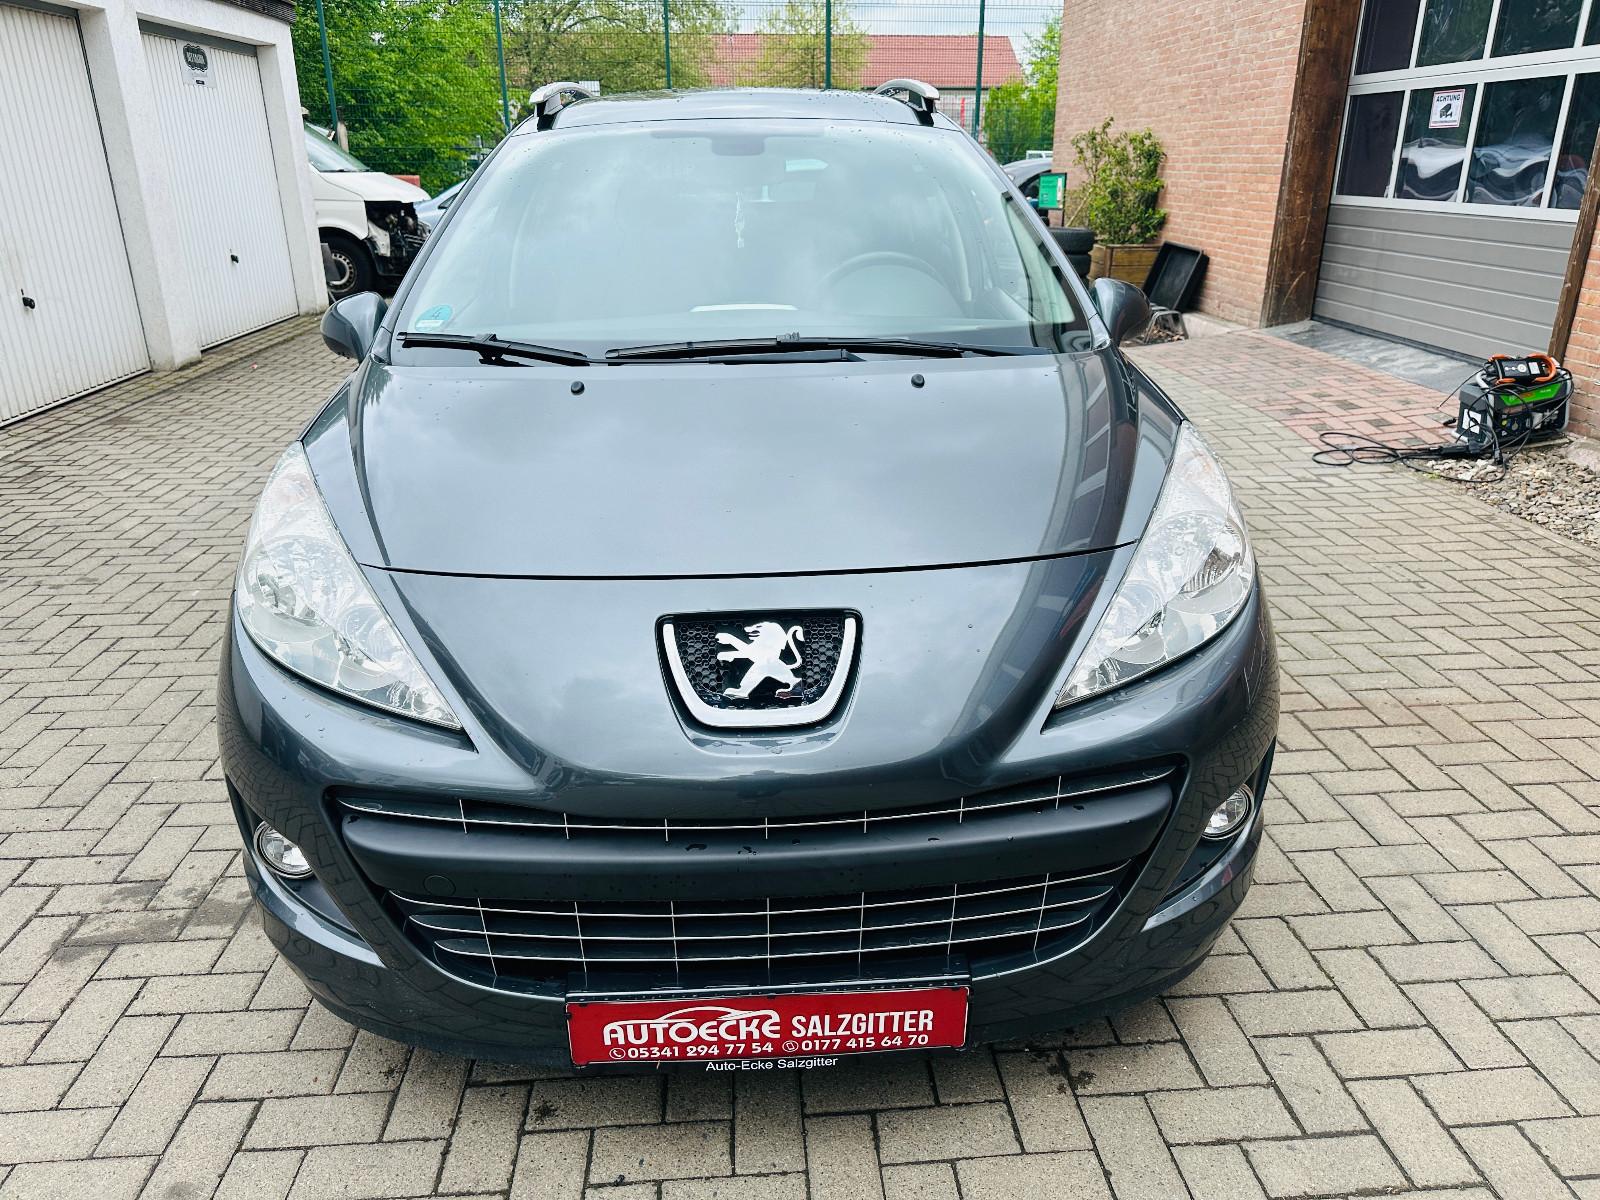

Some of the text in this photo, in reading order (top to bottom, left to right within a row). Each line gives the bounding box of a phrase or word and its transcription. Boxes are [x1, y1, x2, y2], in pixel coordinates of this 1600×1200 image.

[1436, 94, 1461, 103] ACHTUNG
[603, 1009, 934, 1046] AUTOECKE SALZGITTER
[627, 1042, 774, 1059] 05341 294 77 54
[801, 1034, 929, 1051] 0177 415 64 70
[705, 1057, 839, 1072] Auto-Ecke Salzgitter
